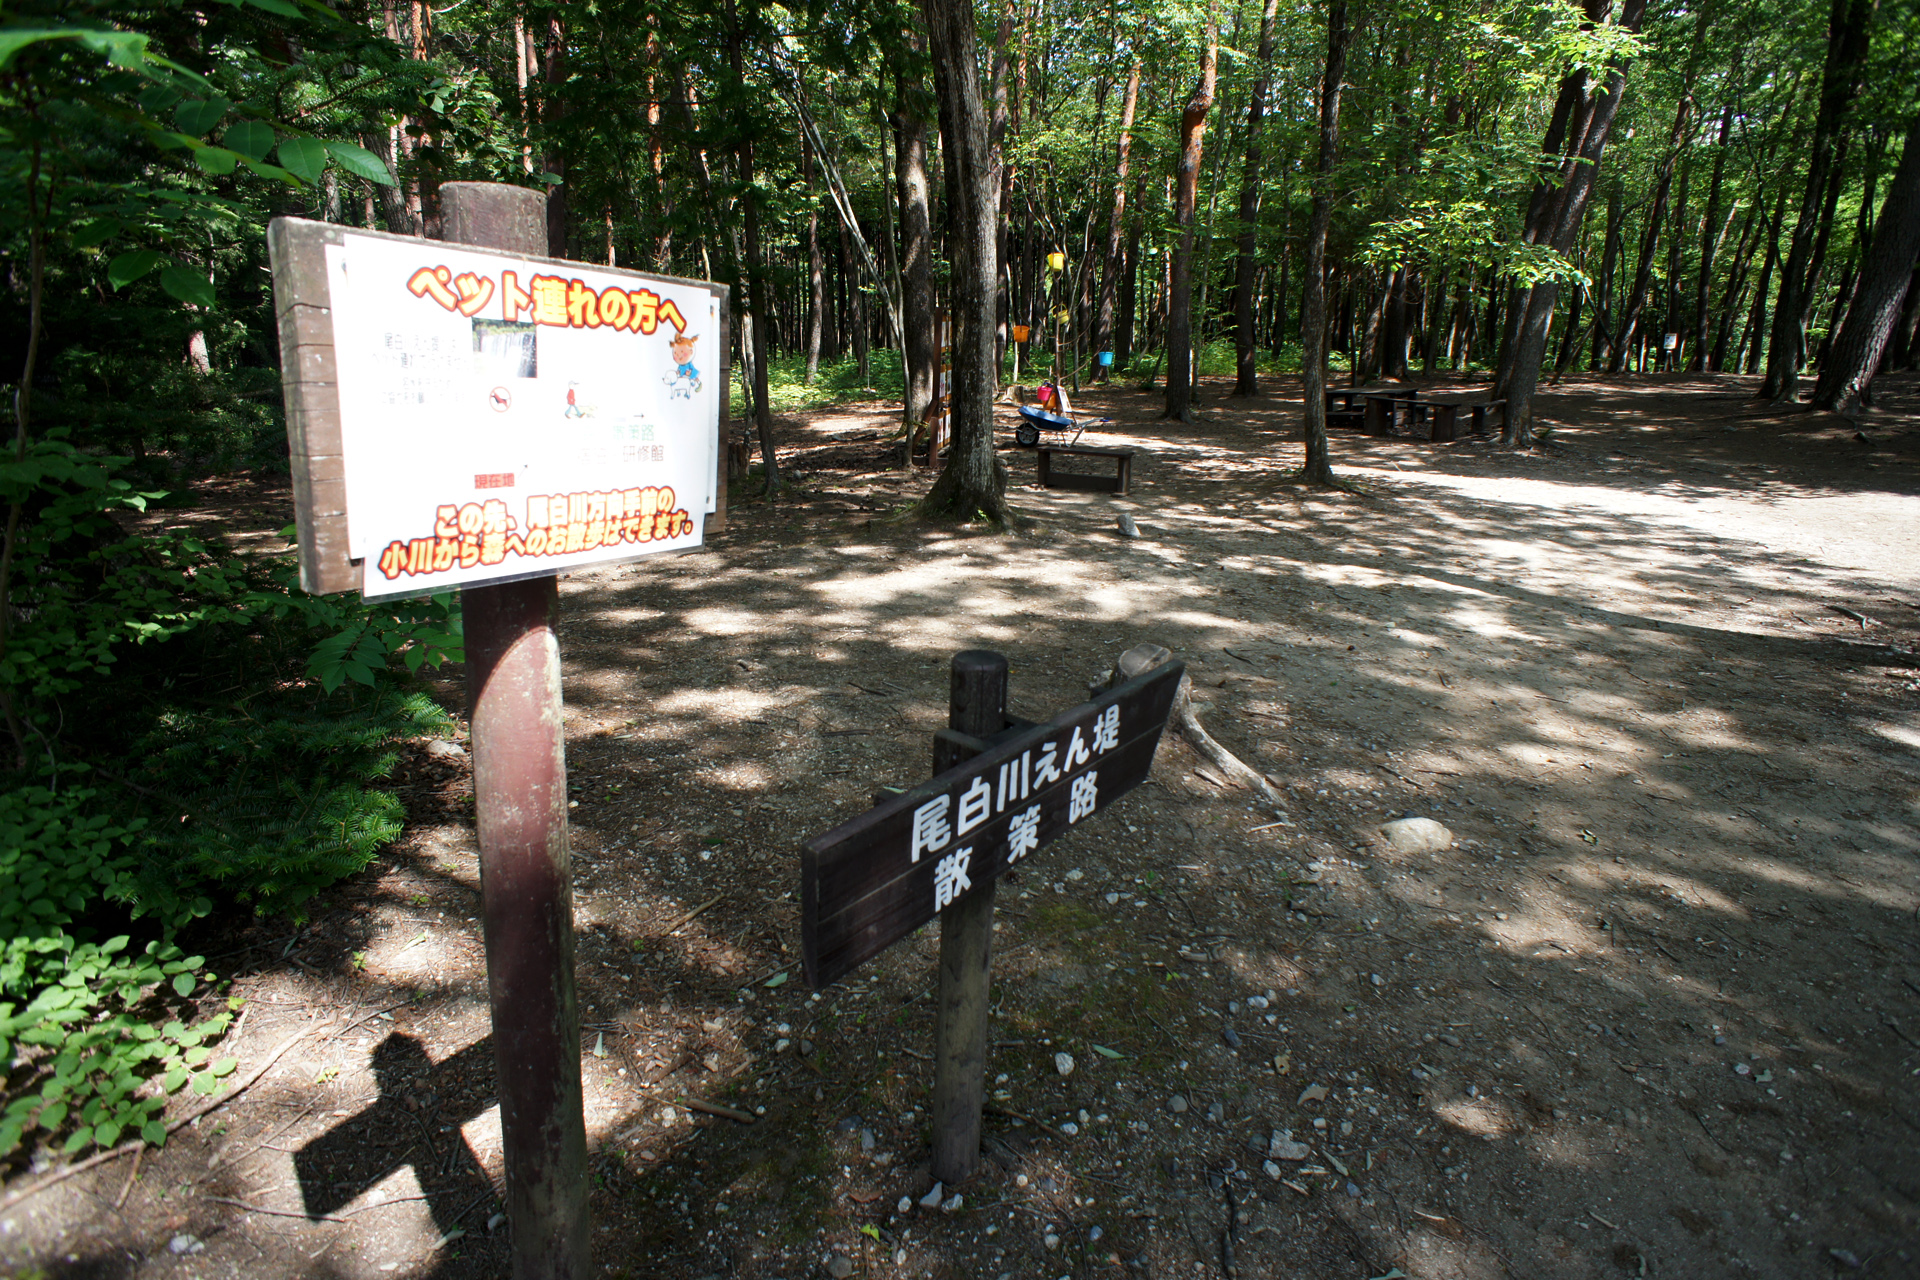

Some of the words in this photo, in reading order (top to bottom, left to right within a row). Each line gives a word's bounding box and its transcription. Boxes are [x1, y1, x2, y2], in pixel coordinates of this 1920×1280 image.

[406, 265, 687, 335] ペット連れの方へ
[434, 486, 676, 539] この先、尾白川方向手前の
[474, 472, 515, 490] 現在地
[377, 509, 695, 580] 小川から森へのお散歩はできます。
[911, 704, 1121, 863] 尾白川えん堤
